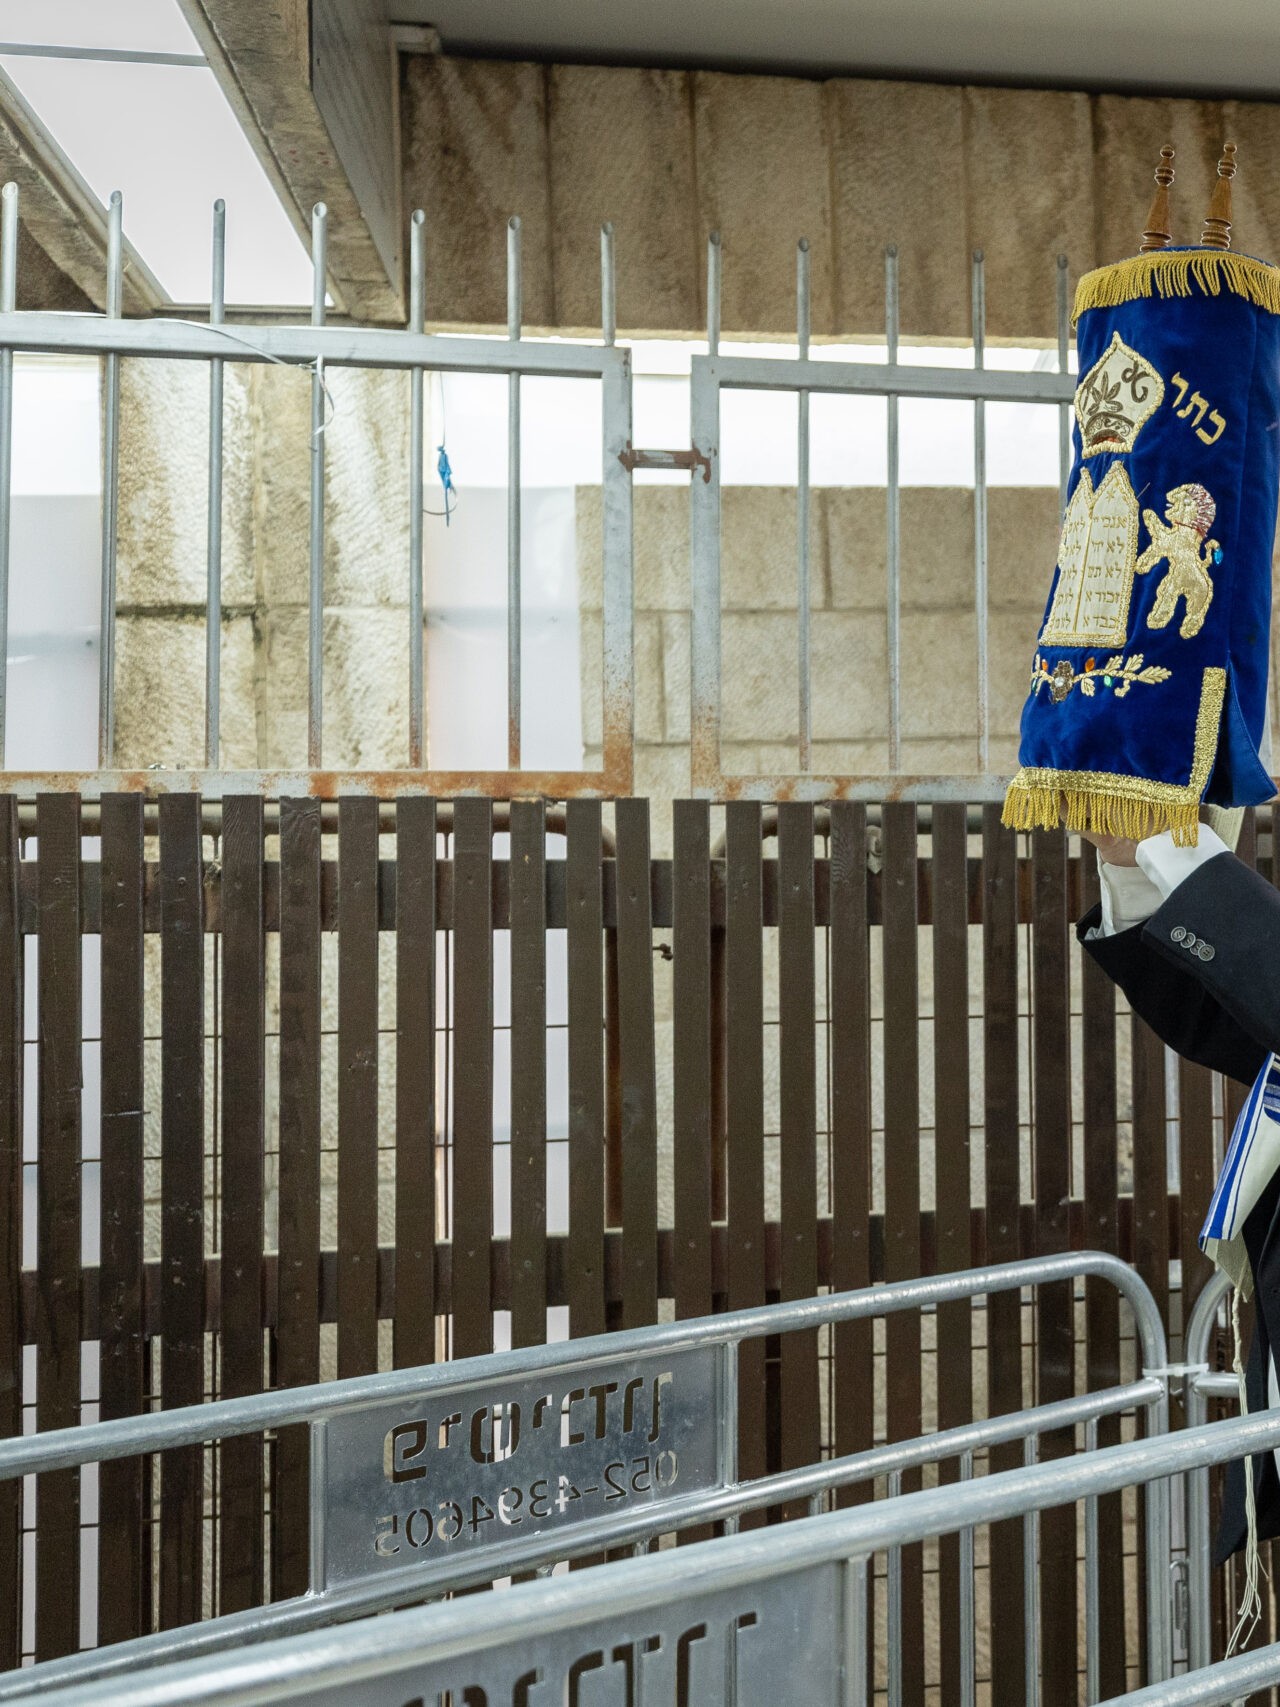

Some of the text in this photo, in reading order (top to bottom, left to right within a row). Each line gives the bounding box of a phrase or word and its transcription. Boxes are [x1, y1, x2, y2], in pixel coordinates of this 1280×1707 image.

[1171, 371, 1227, 446] כתר
[1106, 536, 1125, 554] לא
[1105, 560, 1122, 579] לא
